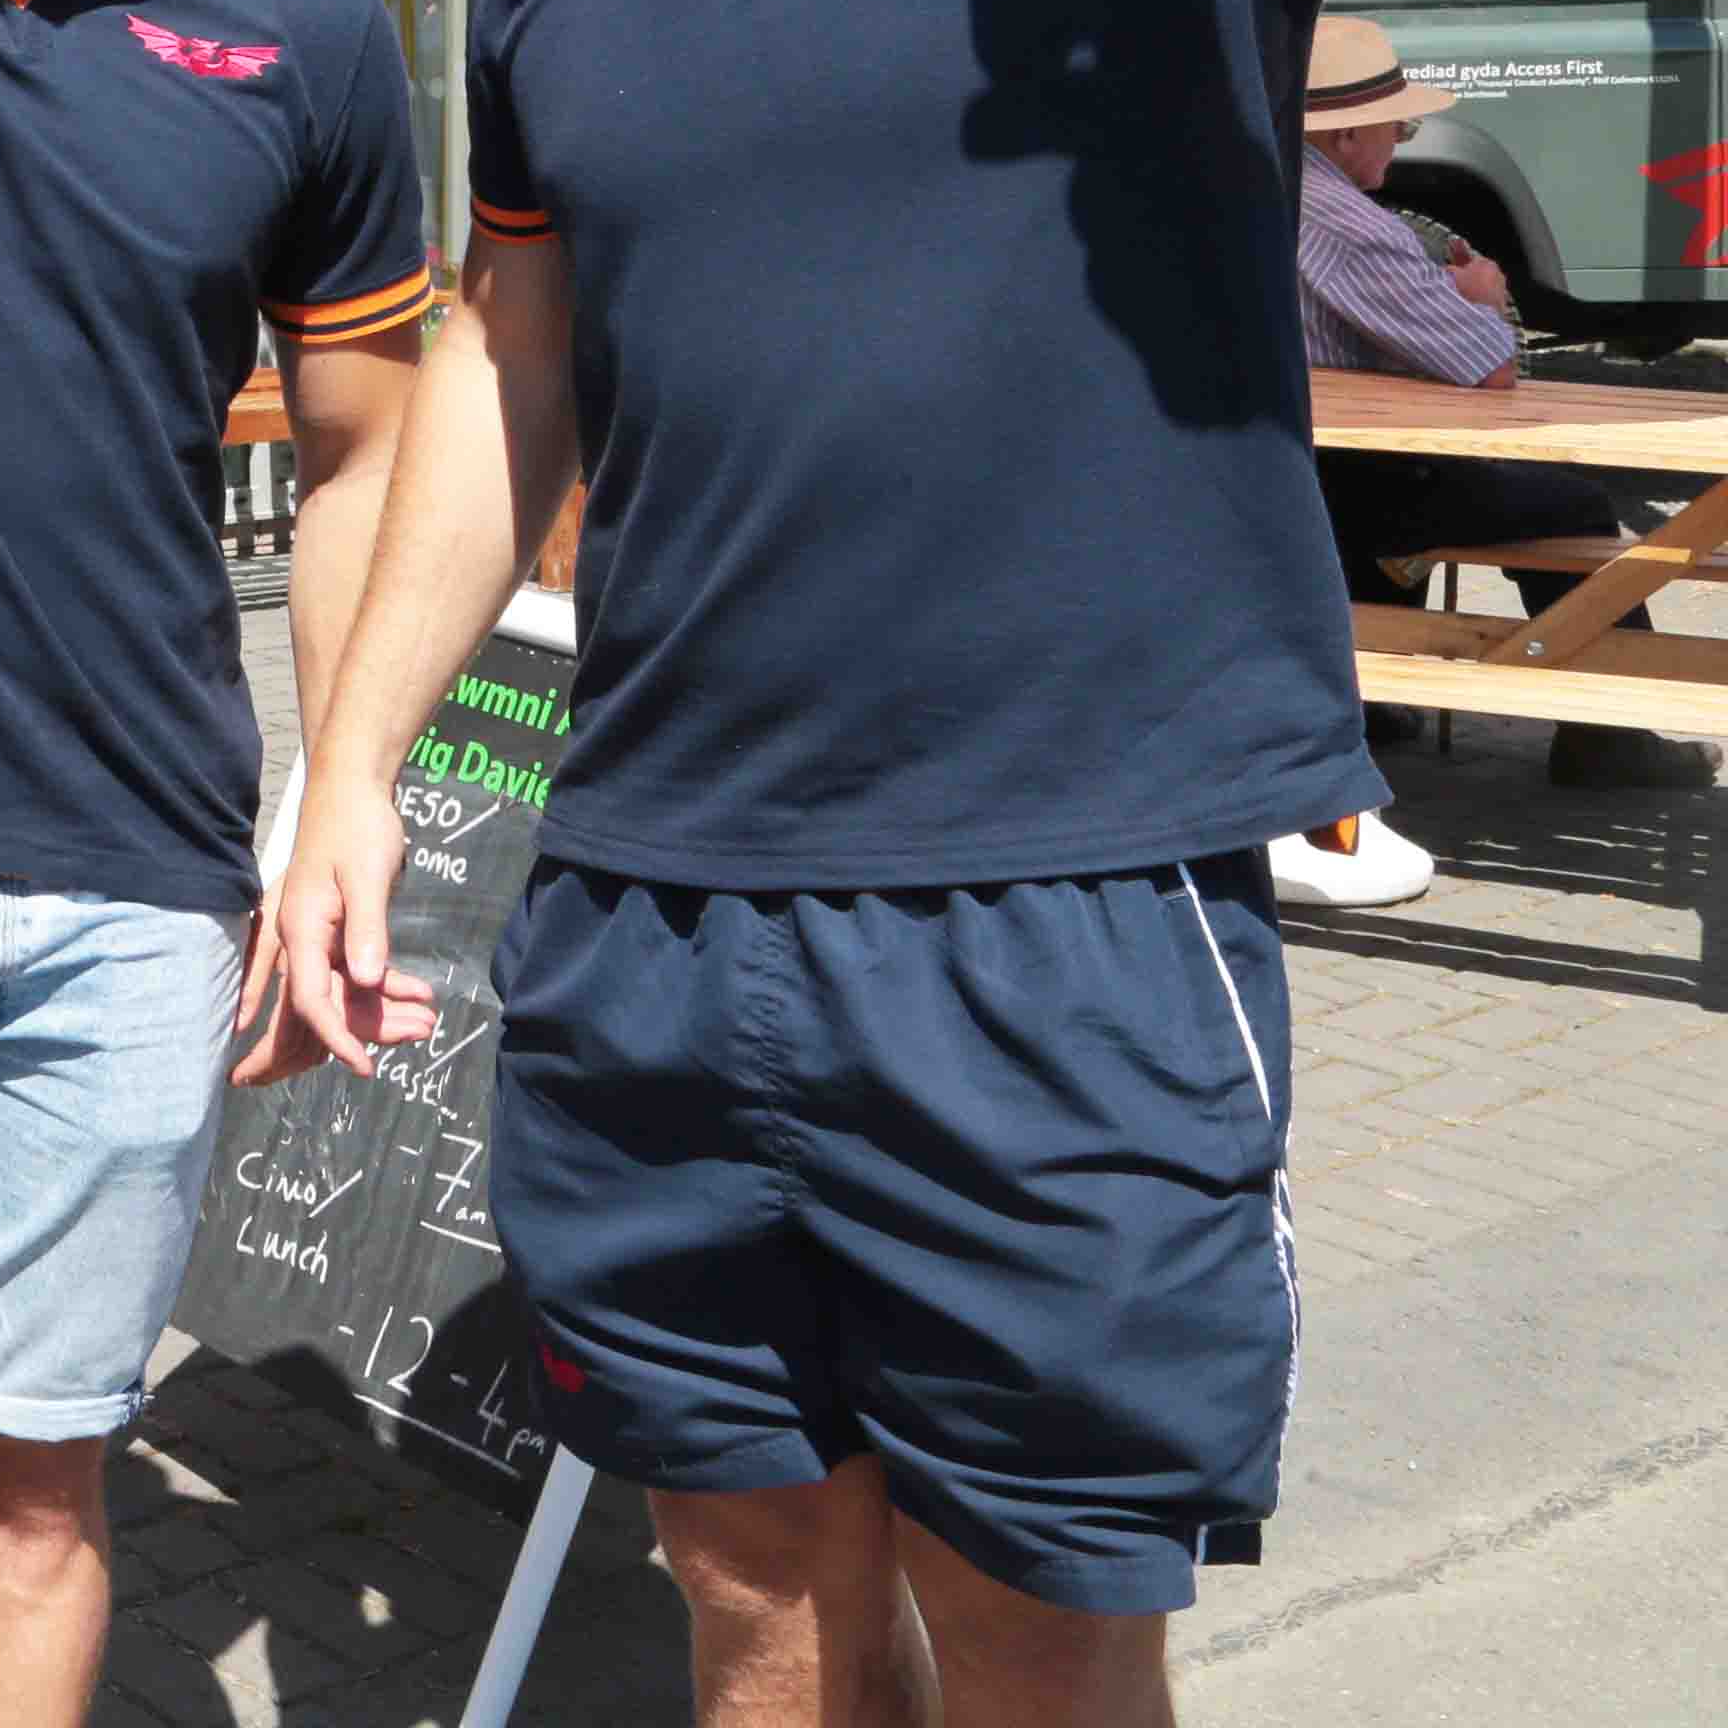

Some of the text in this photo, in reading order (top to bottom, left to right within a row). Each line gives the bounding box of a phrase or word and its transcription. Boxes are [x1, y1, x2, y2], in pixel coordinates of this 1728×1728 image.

[1460, 62, 1500, 81] gyda
[1505, 61, 1563, 77] Access
[1566, 59, 1604, 75] First
[446, 673, 558, 731] wmni
[405, 837, 468, 884] ome
[236, 1215, 329, 1284] Lunch
